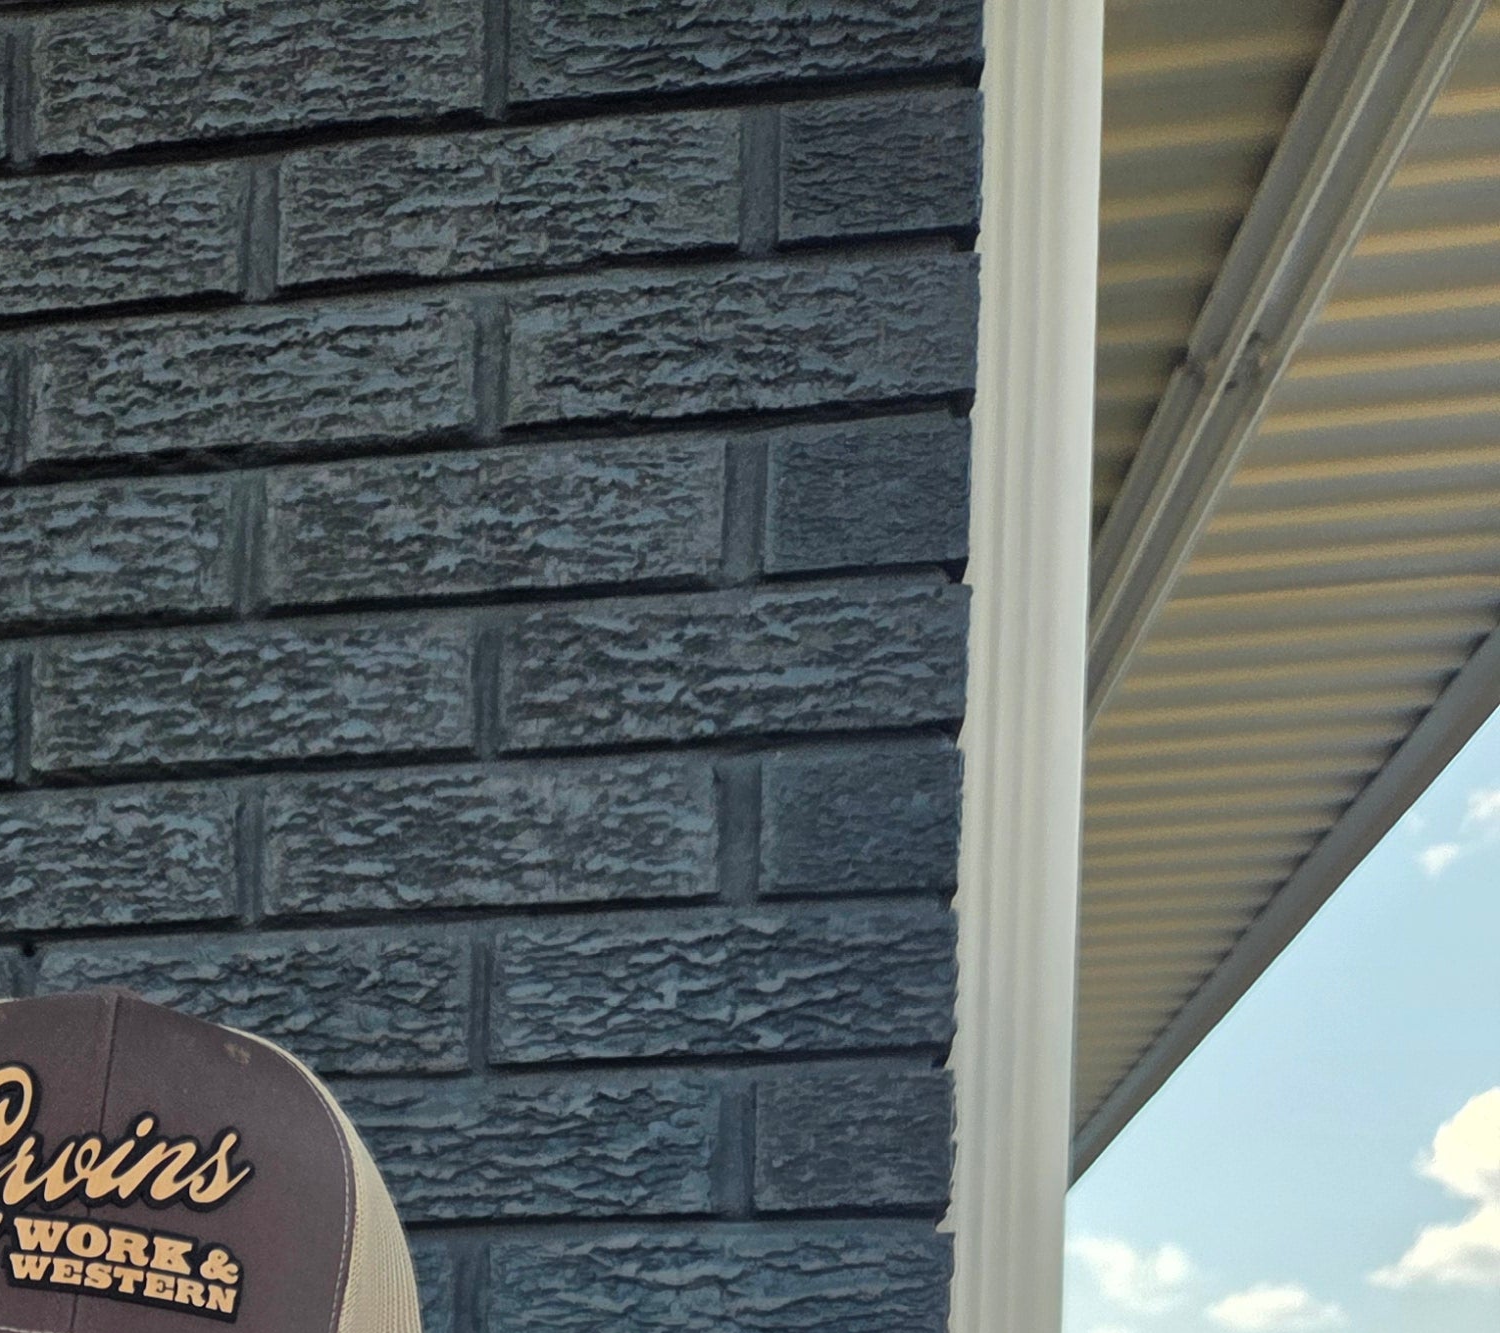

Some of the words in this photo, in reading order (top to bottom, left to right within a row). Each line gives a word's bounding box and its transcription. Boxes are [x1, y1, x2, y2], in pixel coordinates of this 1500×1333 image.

[8, 1252, 239, 1315] WESTERN
[12, 1216, 194, 1276] WORK
[199, 1248, 240, 1285] &
